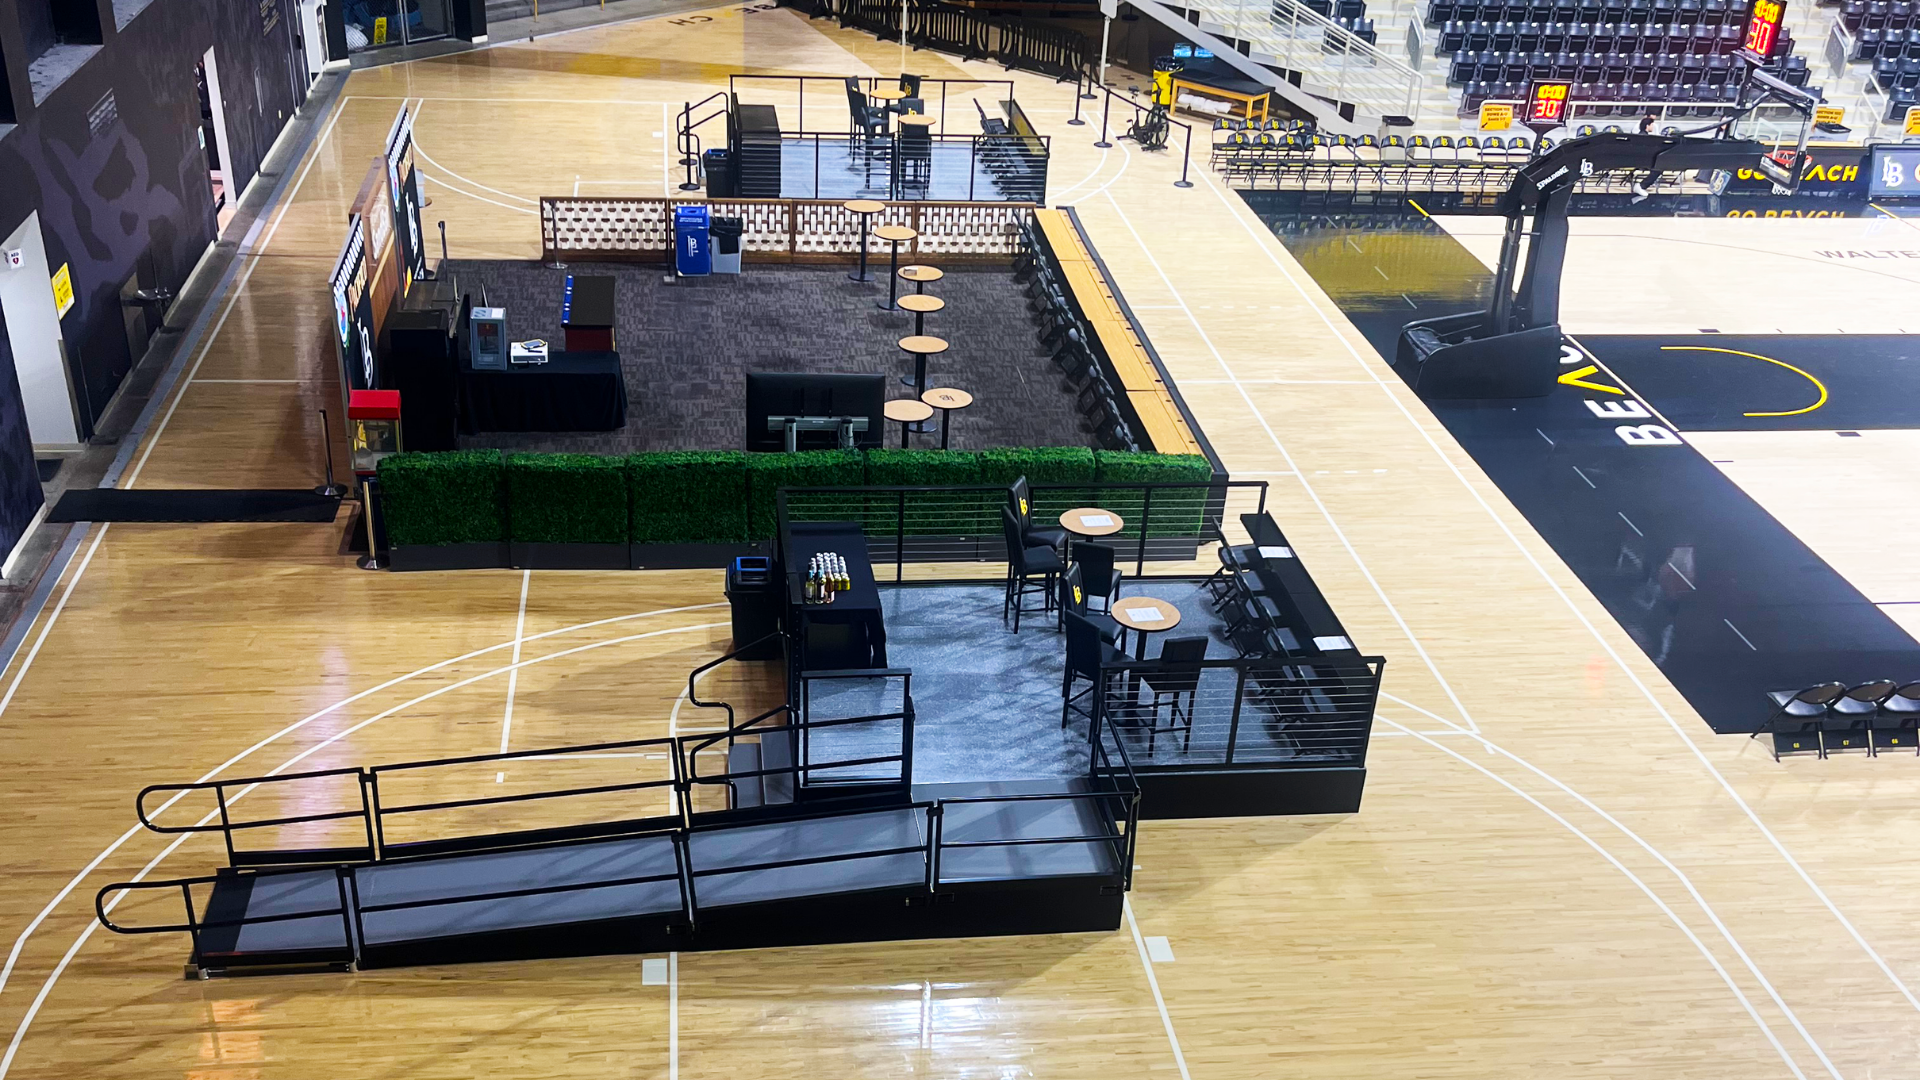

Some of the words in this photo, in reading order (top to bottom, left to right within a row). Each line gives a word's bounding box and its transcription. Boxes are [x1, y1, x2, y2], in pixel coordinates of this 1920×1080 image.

[1746, 17, 1770, 55] 30
[1537, 85, 1567, 99] 10:00
[1535, 100, 1557, 118] 30
[1580, 158, 1594, 177] LB
[1881, 156, 1904, 188] LB
[1536, 165, 1570, 191] SPALDING
[1812, 250, 1920, 259] WALTE
